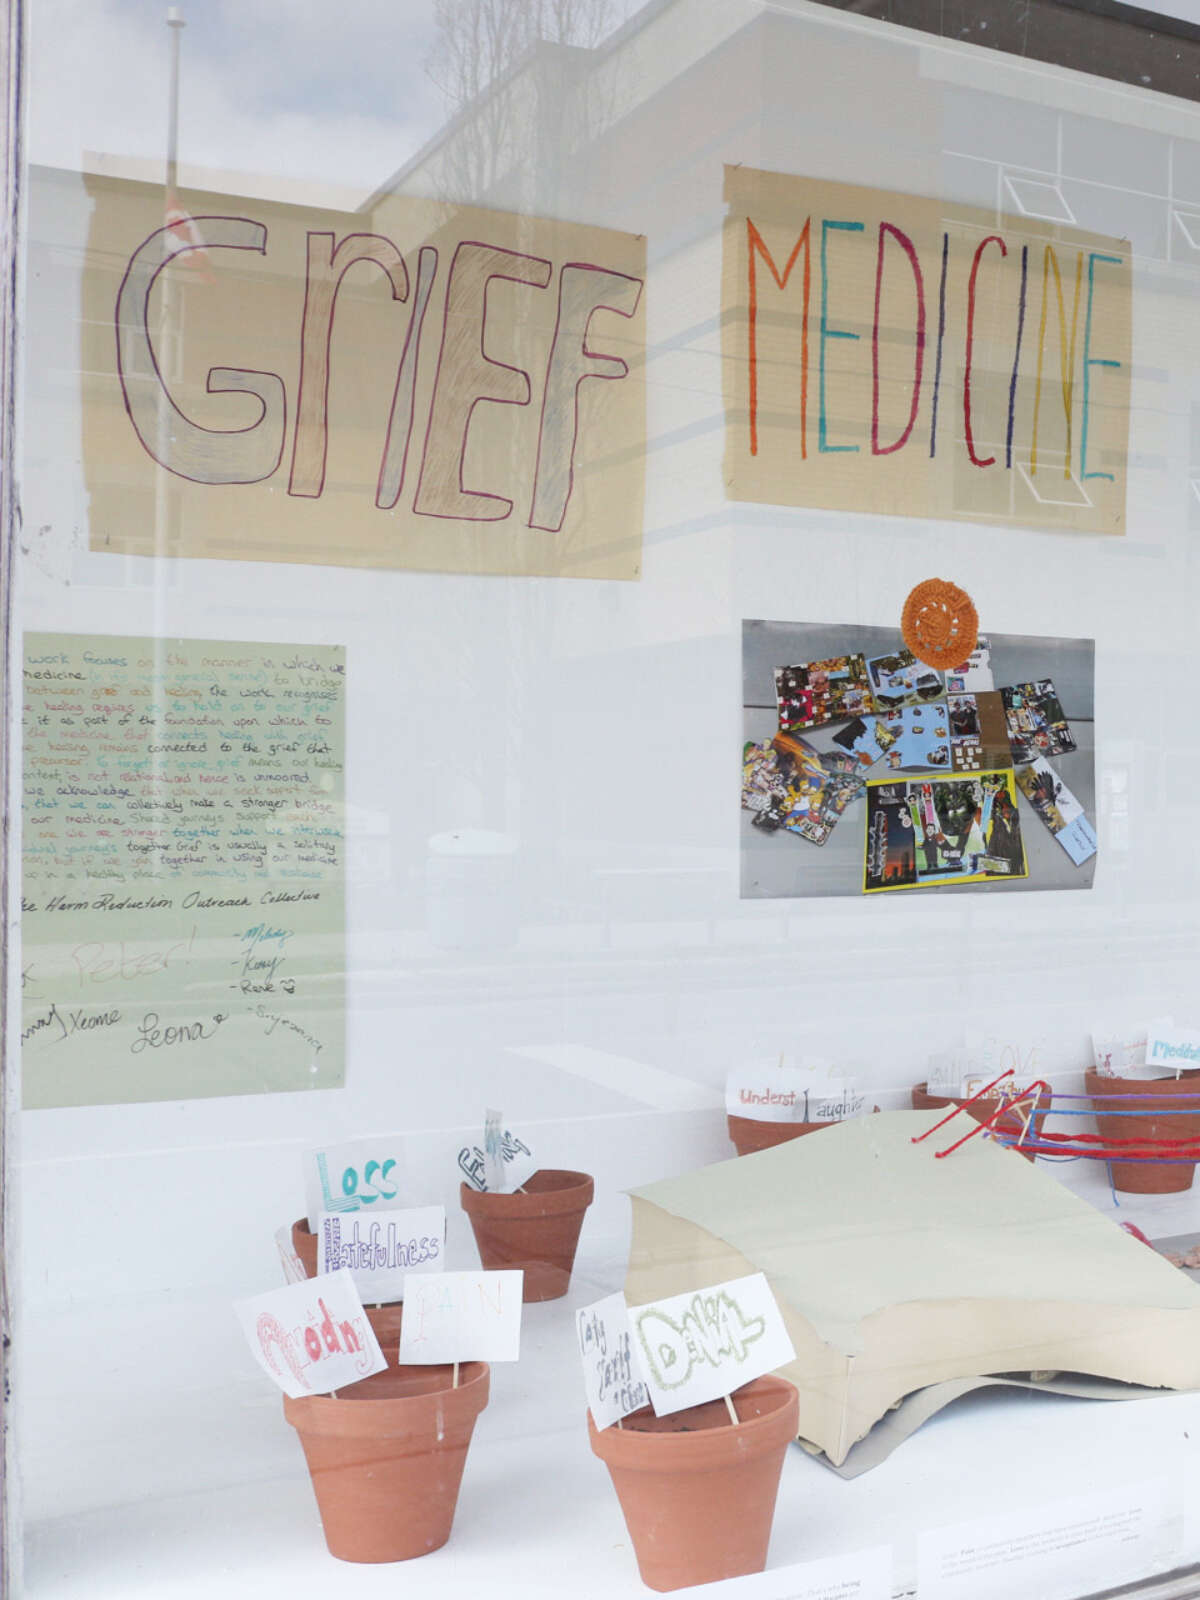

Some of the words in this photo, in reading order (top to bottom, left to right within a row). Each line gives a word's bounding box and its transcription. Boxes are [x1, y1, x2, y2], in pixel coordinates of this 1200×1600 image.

[747, 215, 1122, 481] MEDICINE
[45, 895, 89, 912] Harm
[91, 893, 174, 912] Reduction
